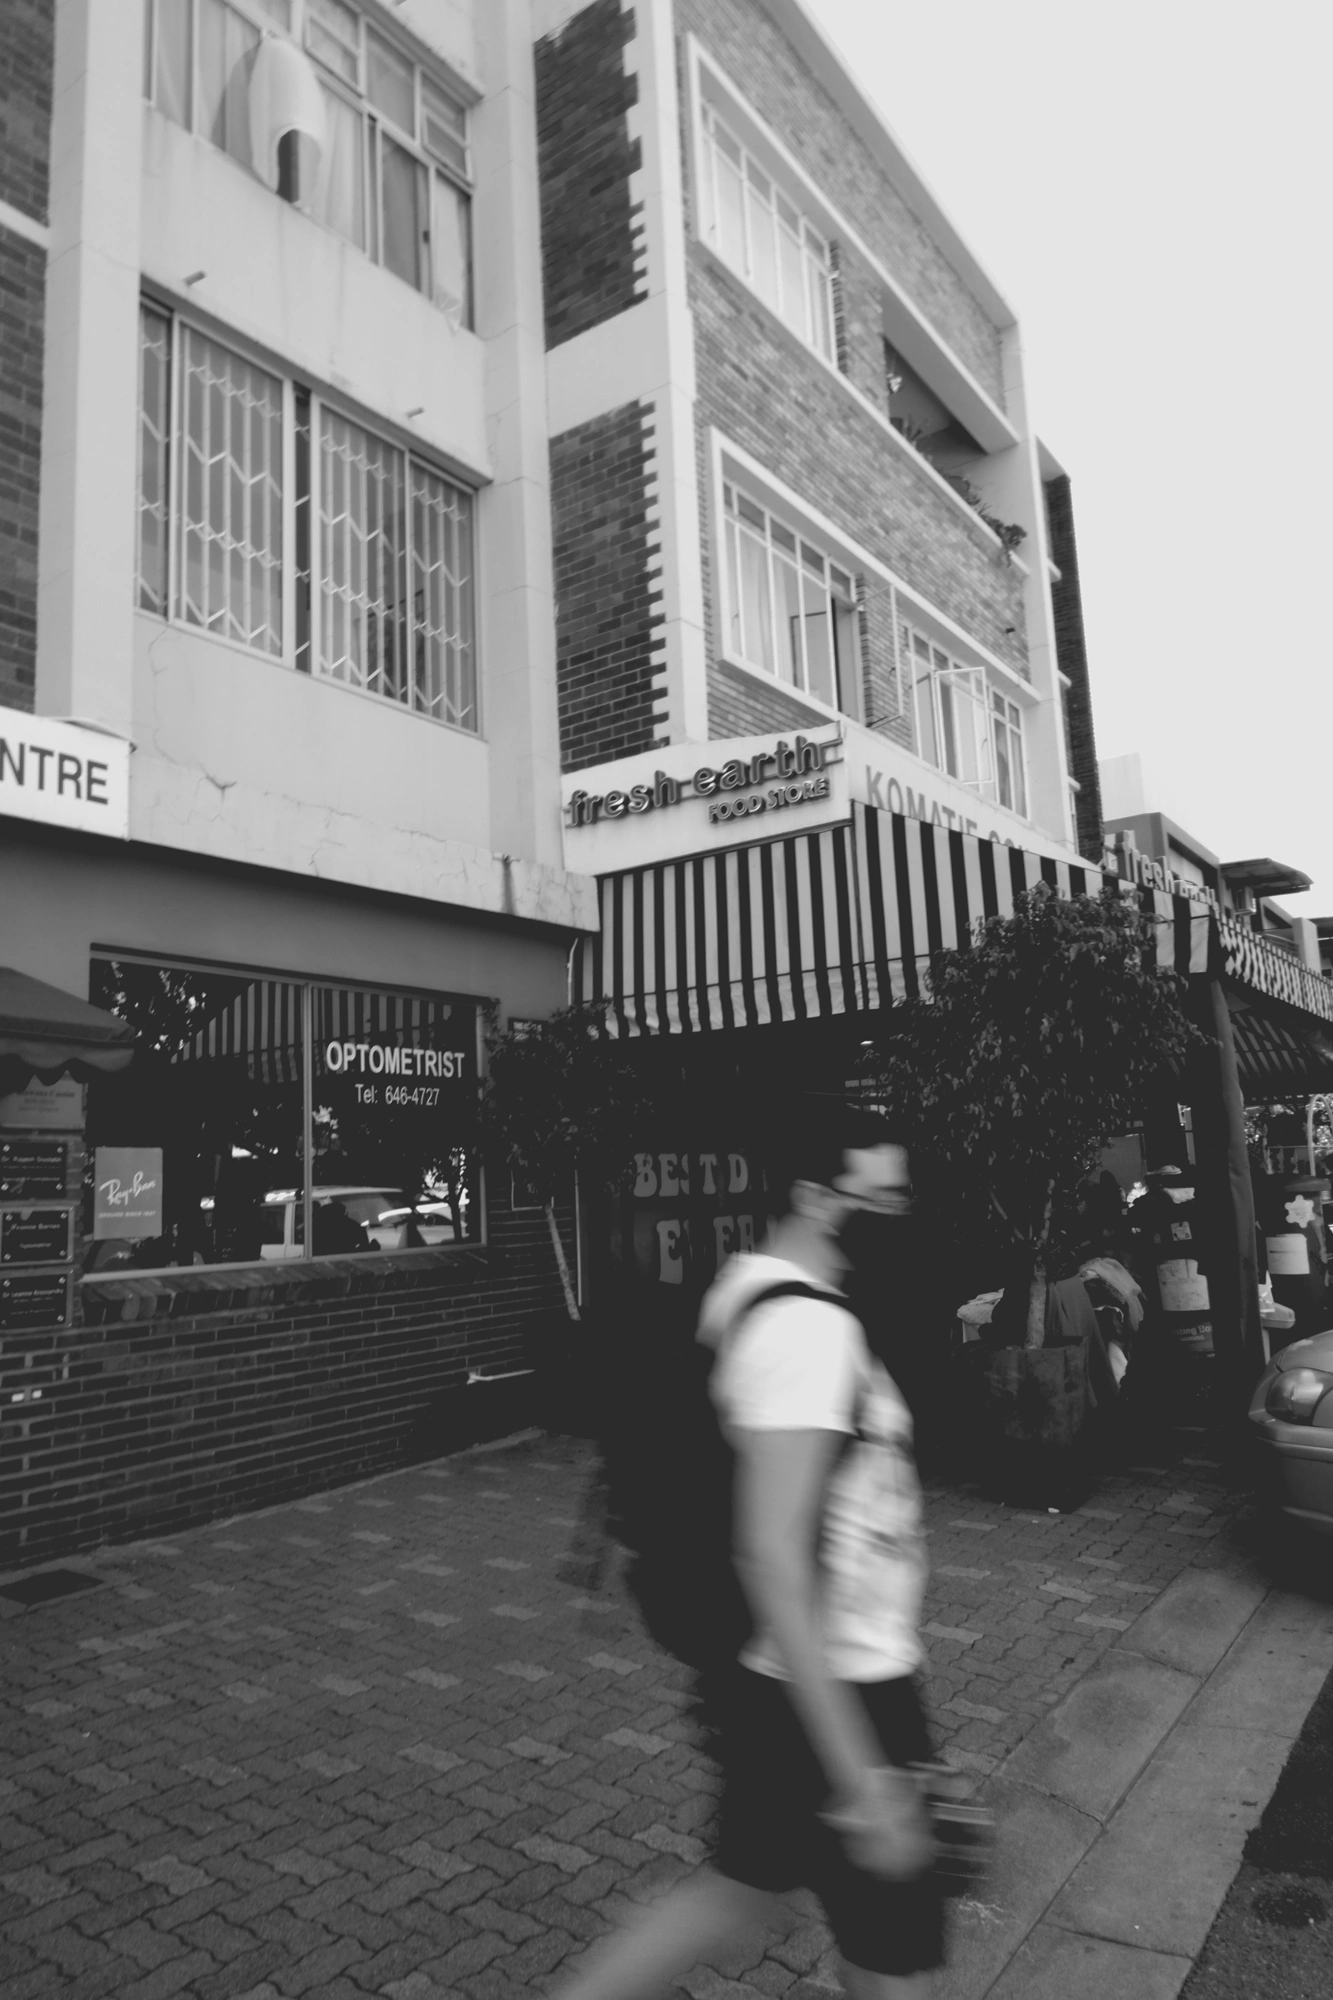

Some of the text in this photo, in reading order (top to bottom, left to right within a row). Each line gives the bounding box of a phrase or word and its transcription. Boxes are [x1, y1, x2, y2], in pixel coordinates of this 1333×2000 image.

[0, 737, 108, 805] NTRE
[567, 735, 827, 828] fresh earth
[708, 777, 830, 824] FOOD STORE
[326, 1040, 466, 1079] OPTOMETRIST
[354, 1082, 440, 1107] Tel: 646-4727
